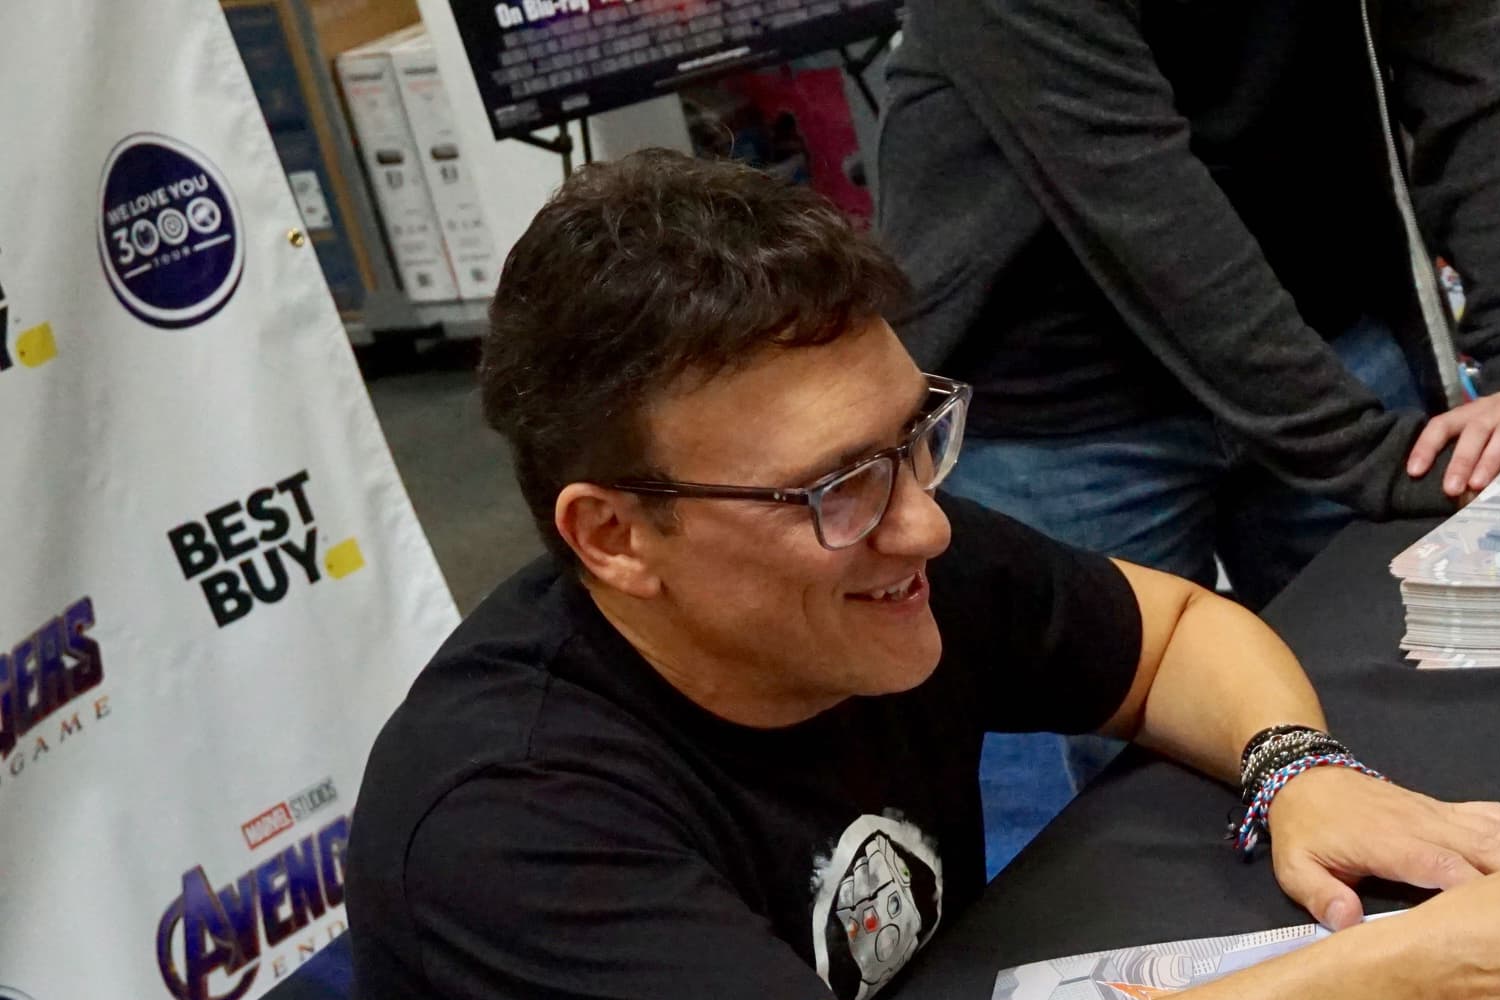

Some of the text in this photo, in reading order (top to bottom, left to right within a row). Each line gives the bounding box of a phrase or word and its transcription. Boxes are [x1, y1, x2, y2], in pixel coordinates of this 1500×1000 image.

[128, 187, 170, 217] LOVE
[167, 173, 209, 199] YOU
[167, 469, 314, 581] BEST
[199, 527, 321, 628] BUY
